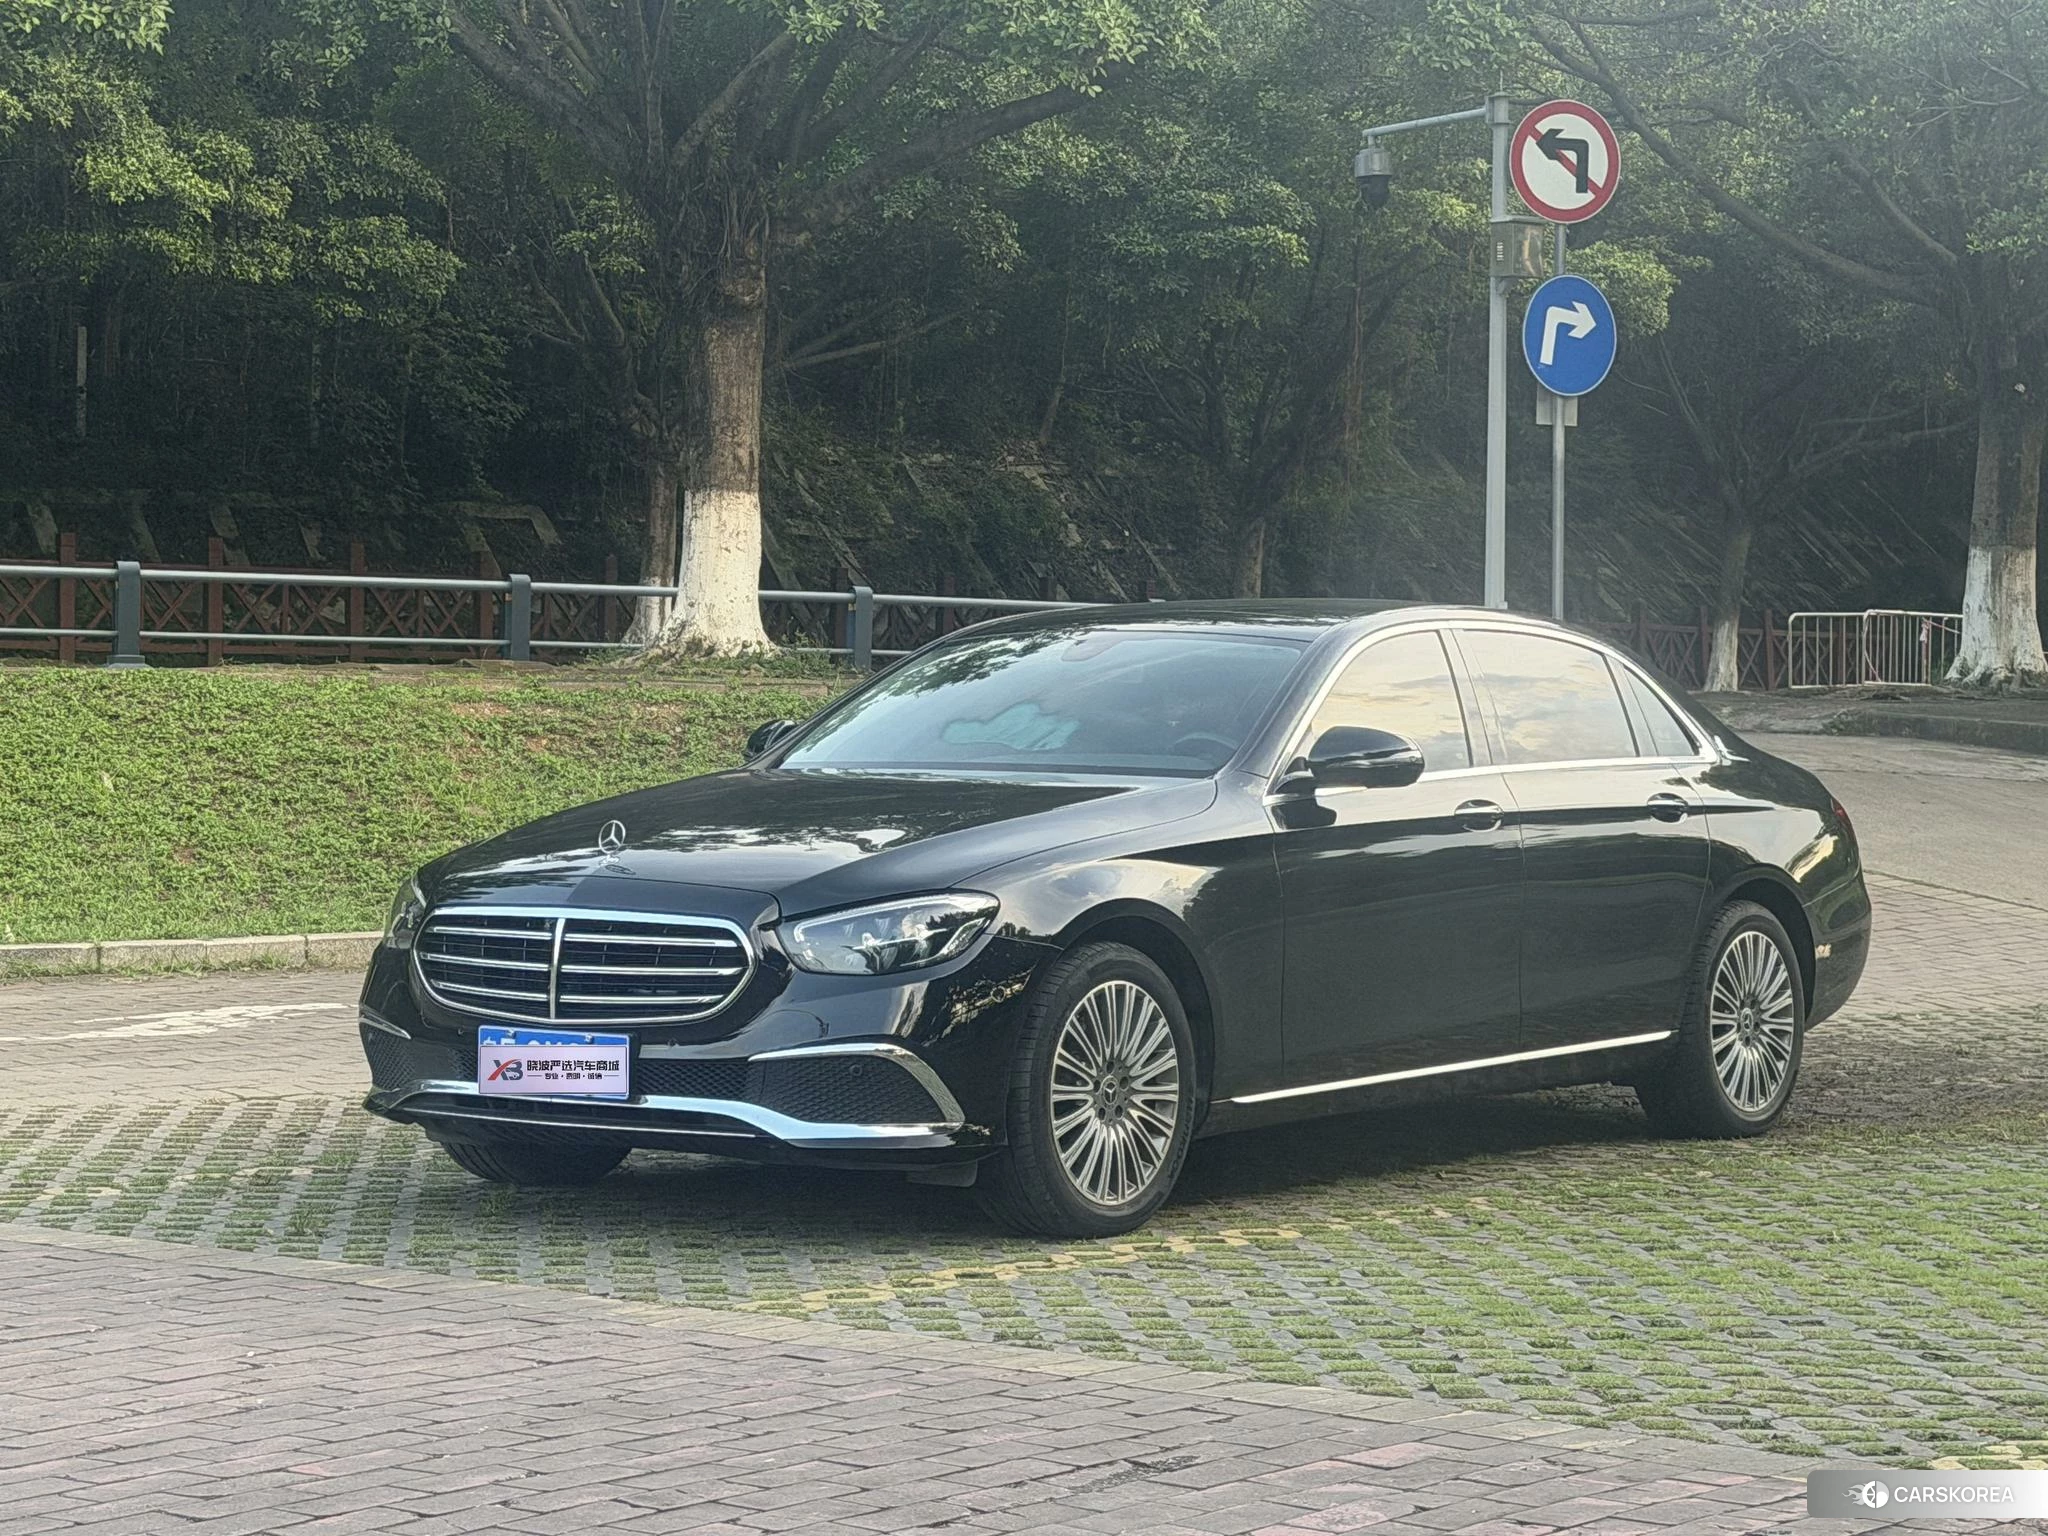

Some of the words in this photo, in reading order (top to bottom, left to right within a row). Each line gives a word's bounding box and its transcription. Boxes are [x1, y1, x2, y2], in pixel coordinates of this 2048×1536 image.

[527, 1060, 620, 1071] 晓波严选汽车商城
